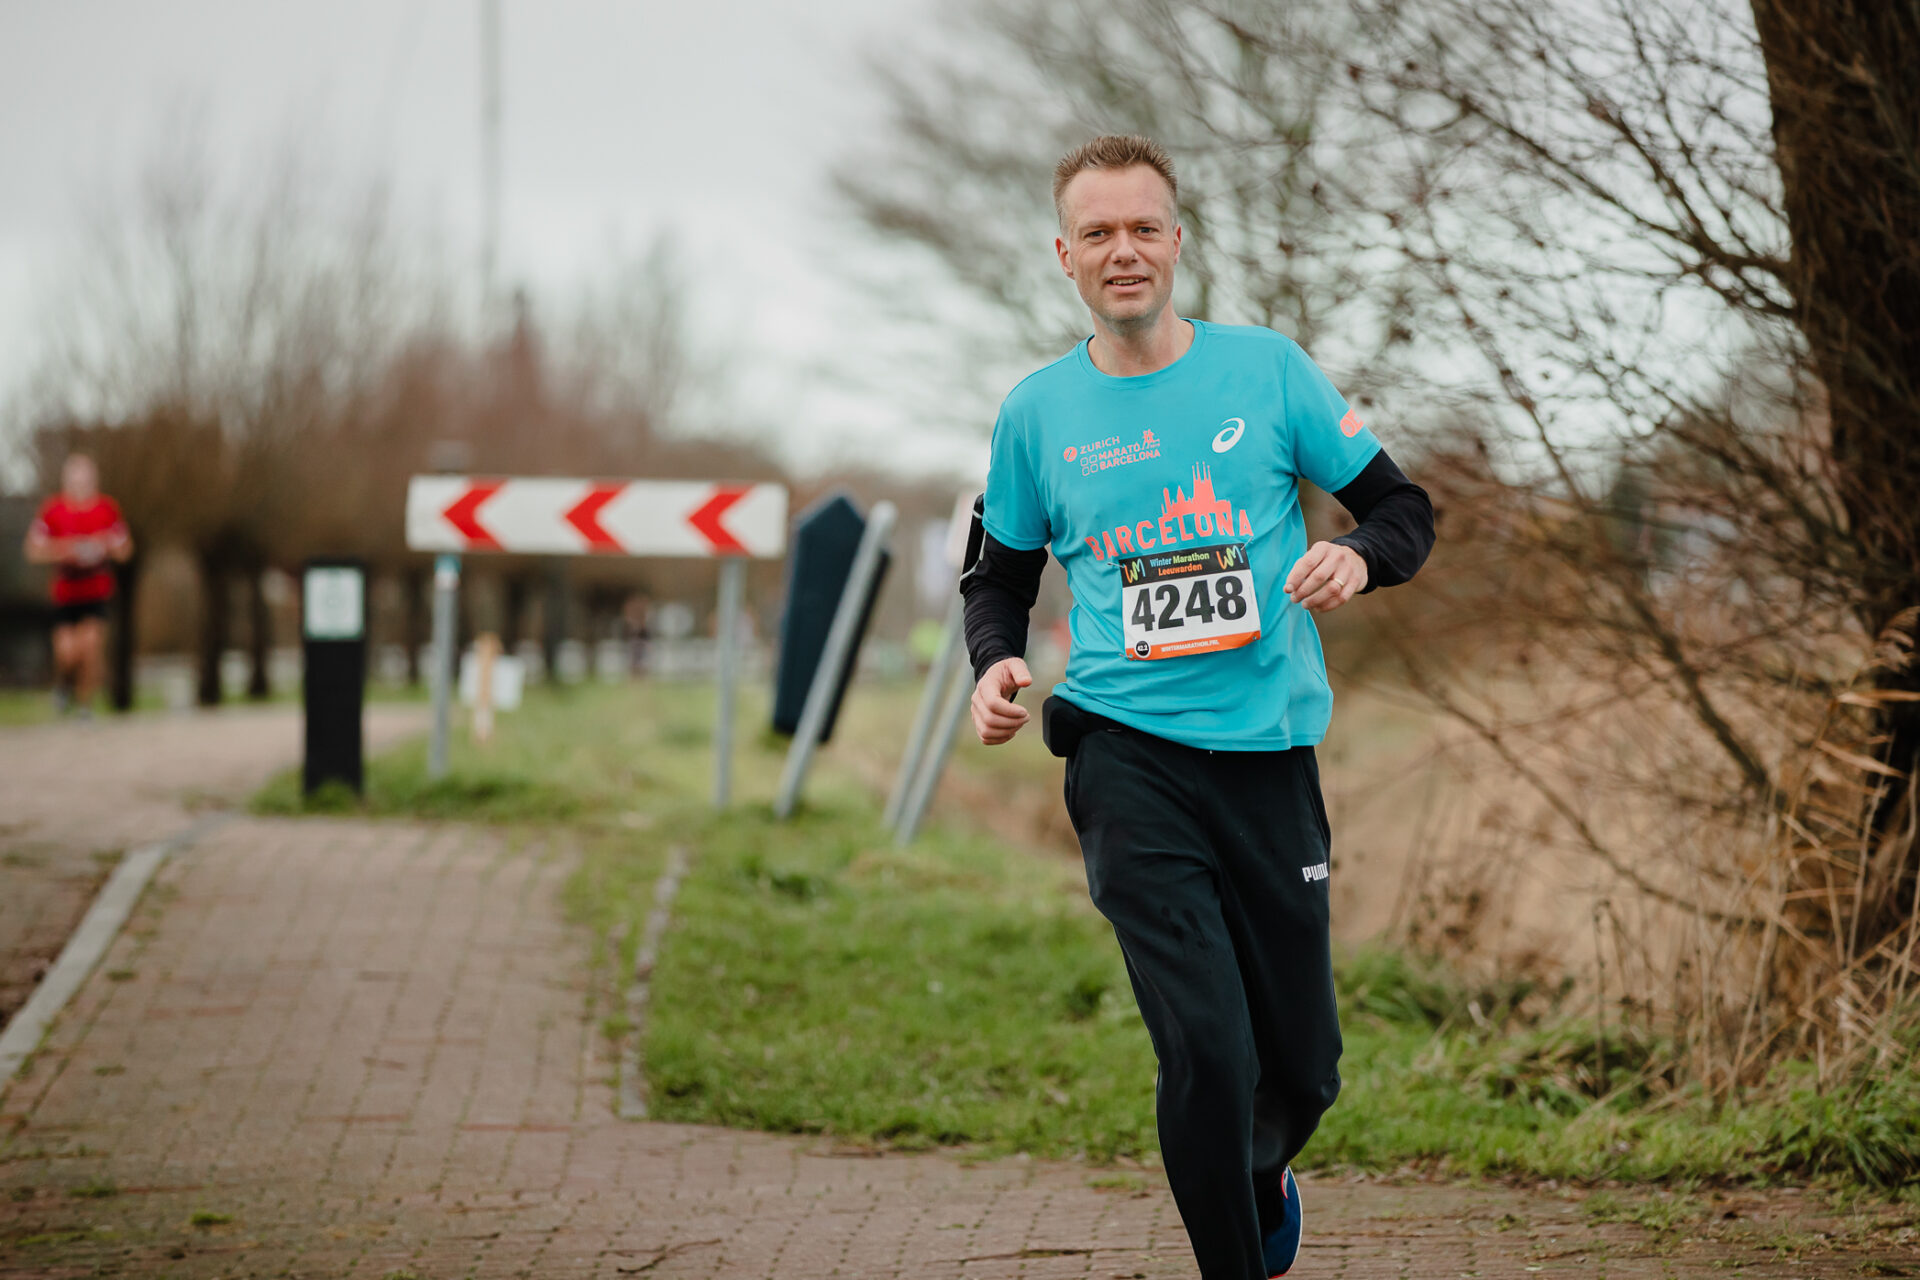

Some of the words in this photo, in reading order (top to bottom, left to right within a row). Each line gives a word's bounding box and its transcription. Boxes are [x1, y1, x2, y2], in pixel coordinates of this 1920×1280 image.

[1080, 436, 1120, 454] ZURICH
[1100, 449, 1160, 470] BARCELONA
[1085, 510, 1254, 561] BARCELONA
[1149, 558, 1172, 568] Winter
[1173, 552, 1210, 564] Marathon
[1158, 563, 1203, 577] Leeuwarden
[1131, 576, 1247, 632] 4248
